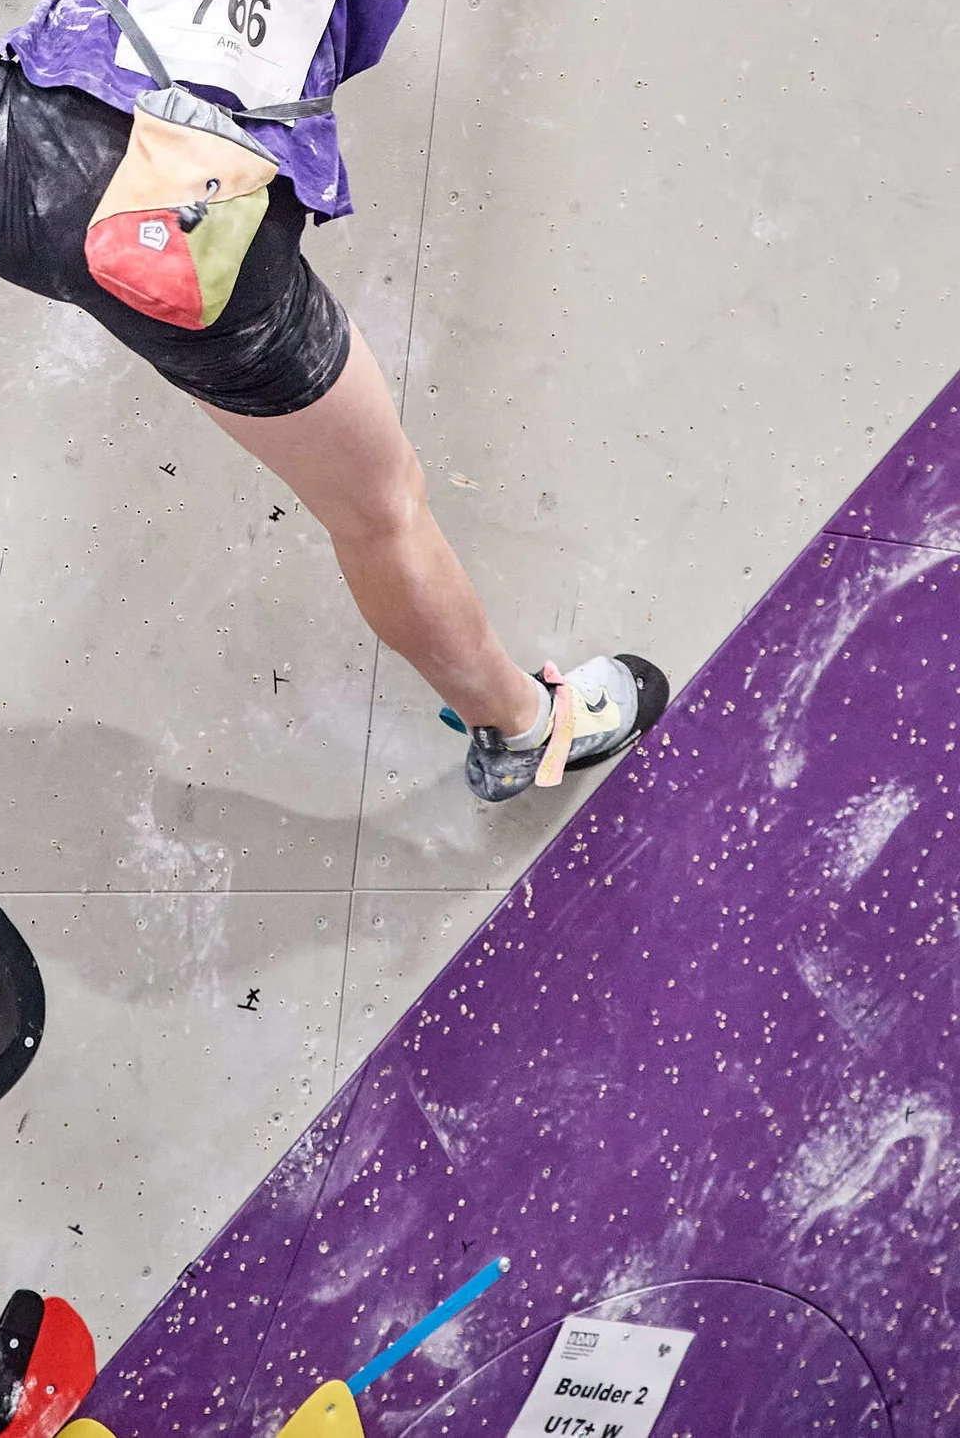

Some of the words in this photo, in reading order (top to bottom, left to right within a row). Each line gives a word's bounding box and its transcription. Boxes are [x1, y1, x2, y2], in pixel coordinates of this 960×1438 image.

[554, 1377, 632, 1404] Boulder
[633, 1386, 649, 1405] 2
[544, 1415, 595, 1437] U17+
[601, 1423, 624, 1438] W
